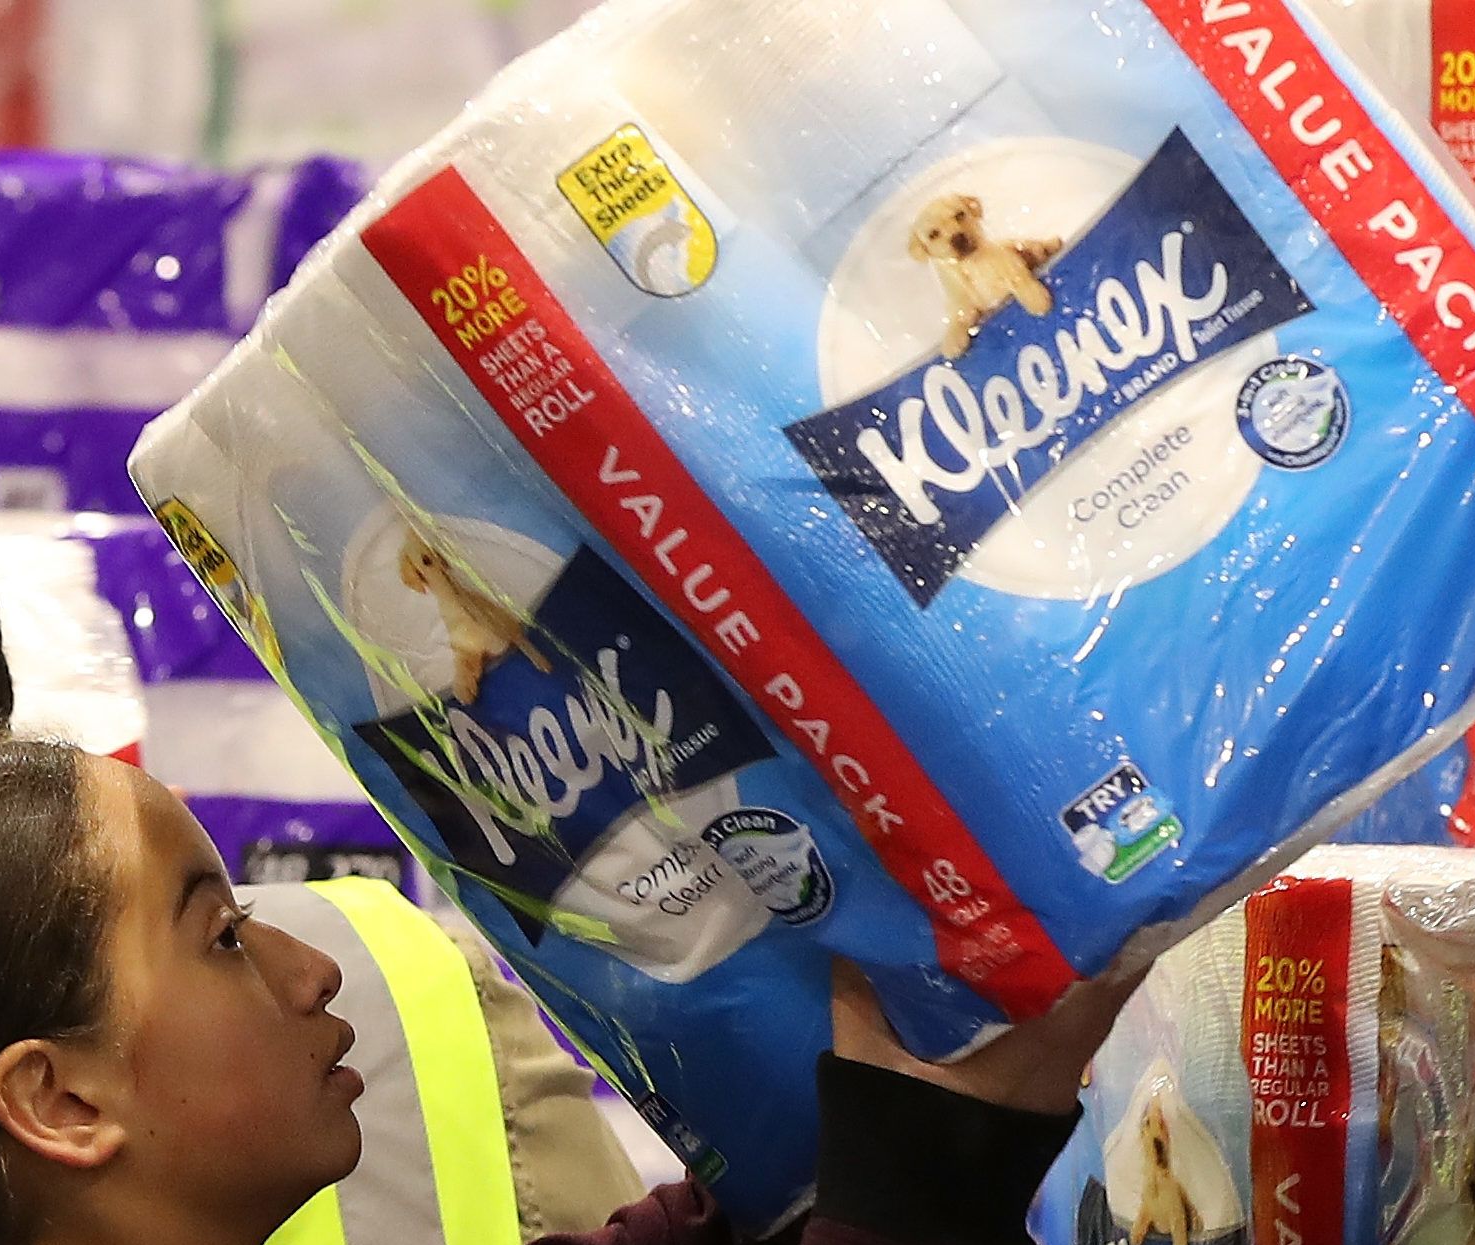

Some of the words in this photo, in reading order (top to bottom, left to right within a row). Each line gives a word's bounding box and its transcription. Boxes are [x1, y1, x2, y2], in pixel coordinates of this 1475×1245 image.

[572, 141, 633, 190] Extra
[594, 172, 668, 231] Sheets
[431, 254, 510, 325] 20%
[454, 285, 527, 351] MORE
[478, 317, 548, 377] SHEETS
[494, 352, 543, 394] THAN
[542, 341, 562, 361] A
[856, 231, 1229, 526] Kleenex
[1120, 351, 1179, 403] BRAND
[523, 377, 596, 438] ROLL
[1072, 422, 1195, 525] Complete
[1116, 468, 1192, 532] Clean
[598, 445, 760, 656] VALUE
[764, 671, 905, 836] PACK
[1073, 775, 1128, 822] TRY
[922, 858, 973, 905] 48
[1255, 956, 1326, 995] 20%
[1253, 996, 1325, 1025] MORE
[1252, 1031, 1328, 1057] SHEETS
[1252, 1056, 1306, 1078] THAN
[1312, 1058, 1330, 1079] A
[1249, 1078, 1330, 1097] REGULAR
[1252, 1099, 1327, 1129] ROLL
